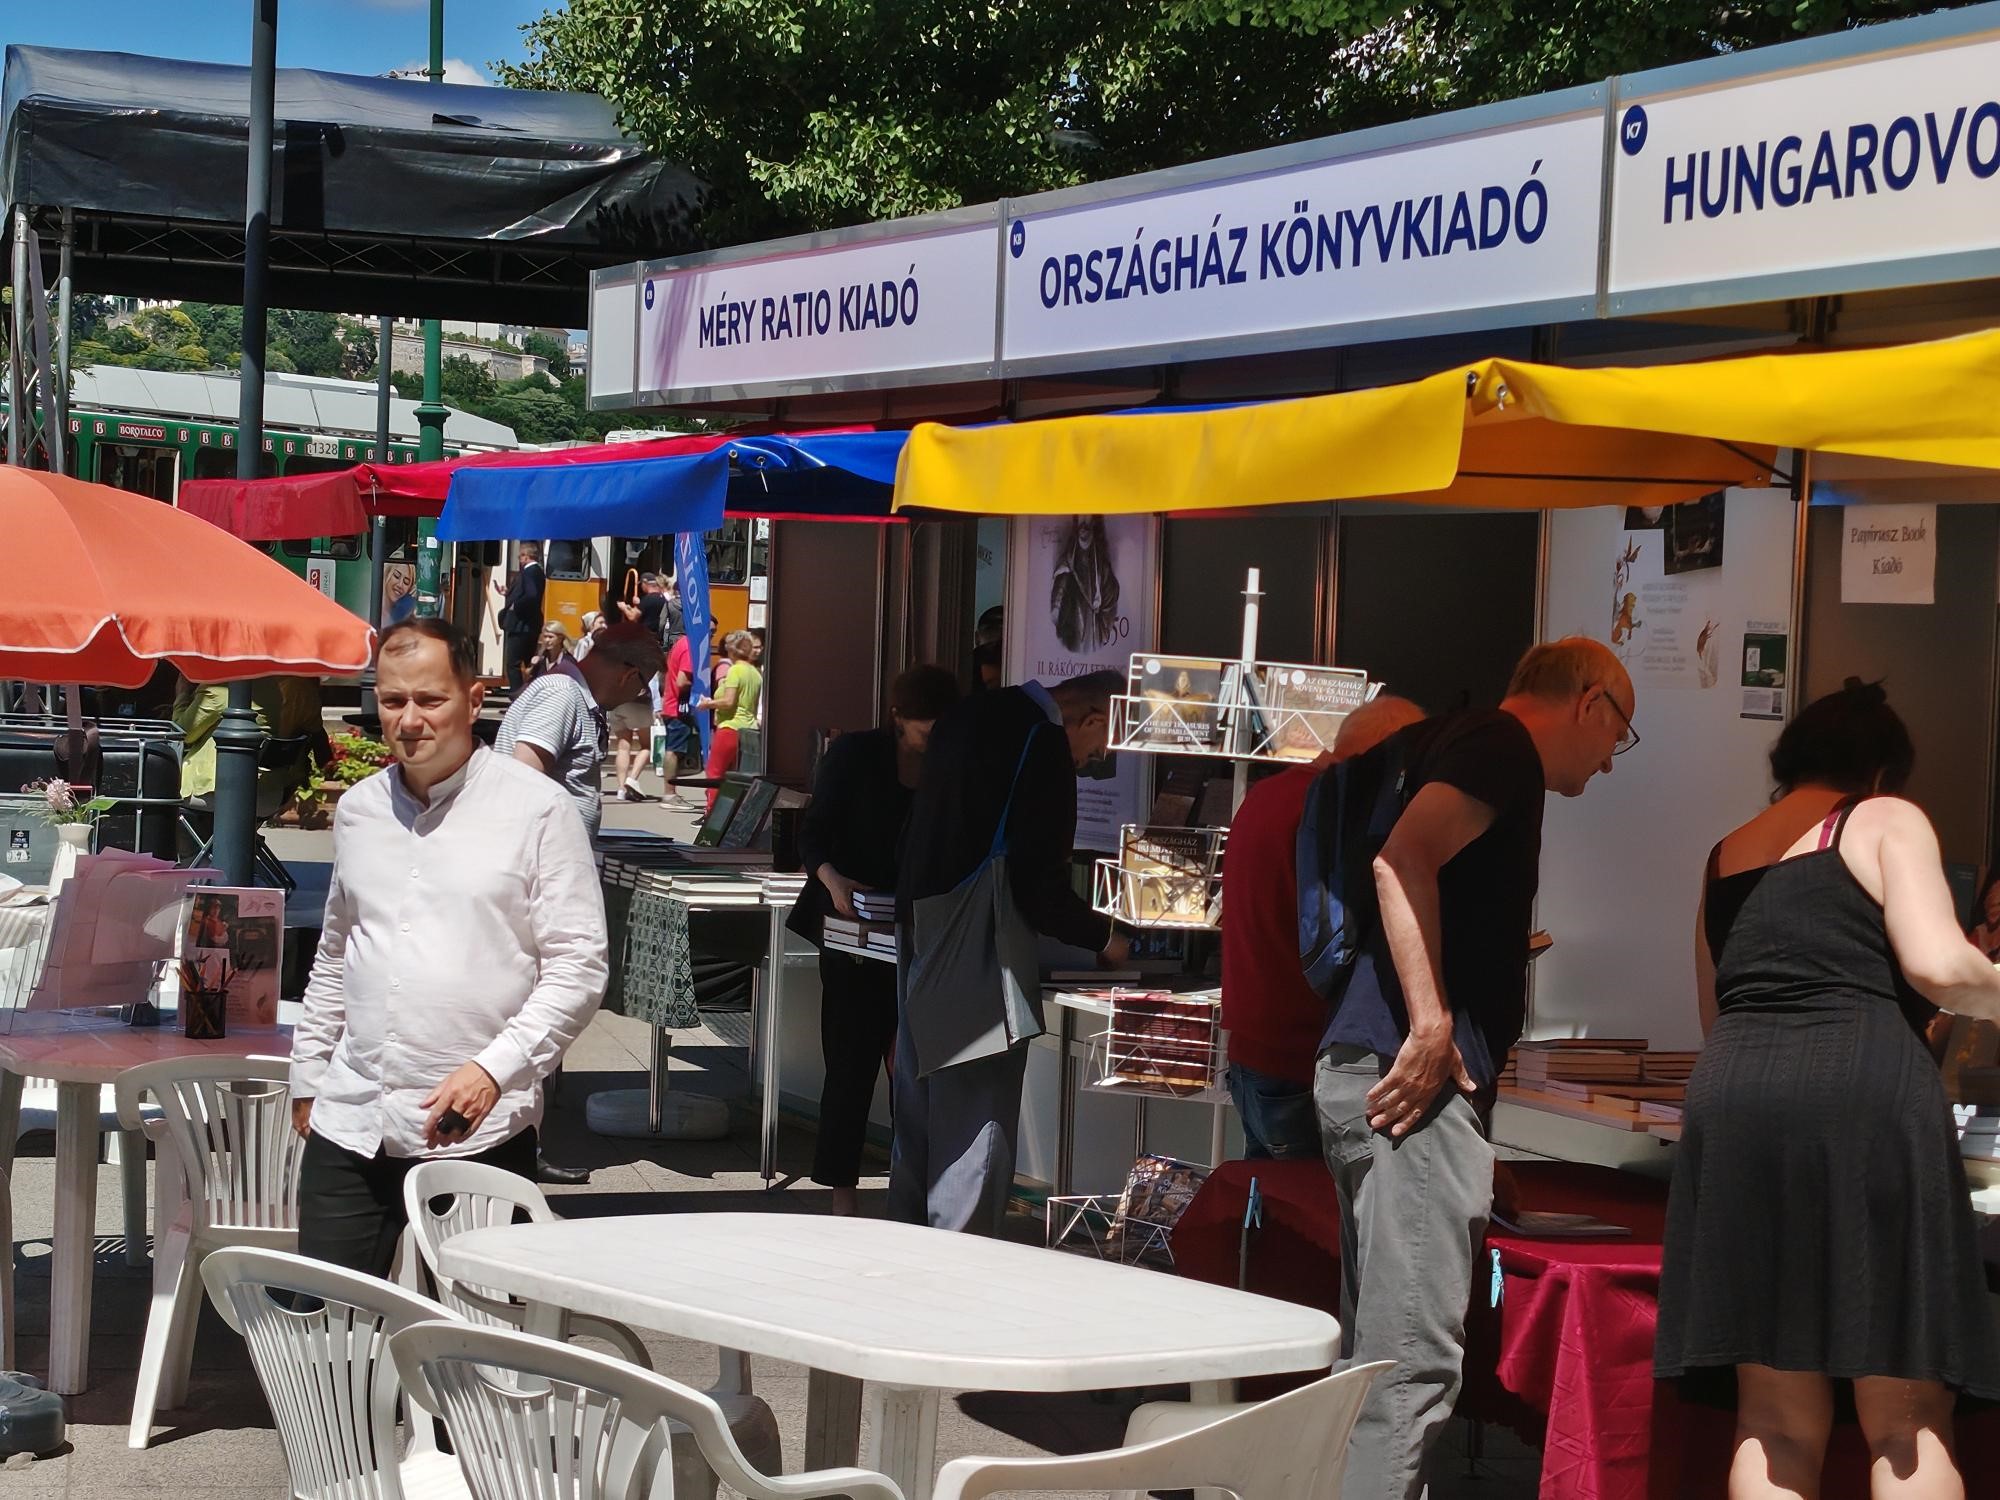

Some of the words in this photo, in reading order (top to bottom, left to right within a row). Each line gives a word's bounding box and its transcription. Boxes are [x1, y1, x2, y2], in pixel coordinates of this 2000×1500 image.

[1626, 122, 1641, 140] K7
[1040, 213, 1248, 309] ORSZÁGHÁZ
[1260, 159, 1548, 280] KÖNYVKIADÓ
[700, 291, 756, 348] MÉRY
[762, 288, 831, 341] RATIO
[839, 263, 919, 332] KIADÓ
[120, 425, 163, 438] BOROTALCO
[313, 442, 338, 455] 1328
[1902, 517, 1927, 542] Book
